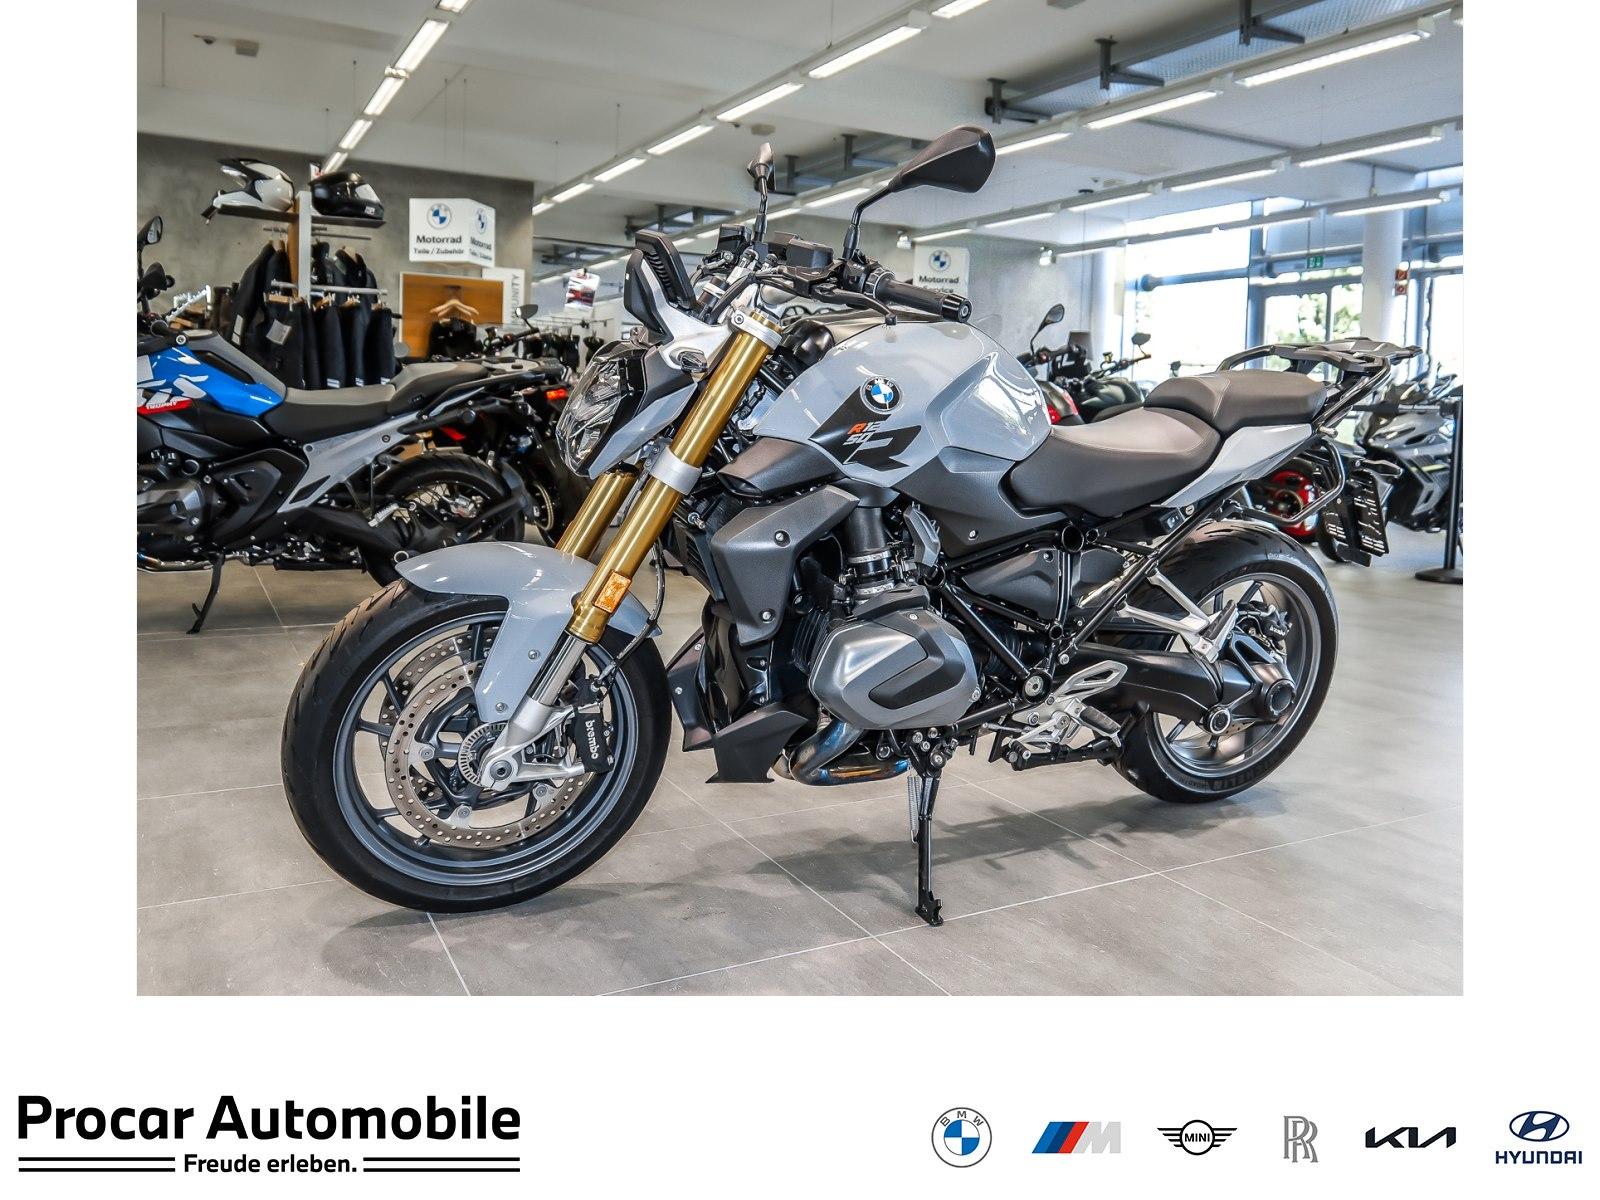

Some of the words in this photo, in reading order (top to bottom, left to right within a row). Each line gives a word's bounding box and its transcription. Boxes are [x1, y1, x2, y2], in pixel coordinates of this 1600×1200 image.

[416, 235, 462, 244] Motorrad
[919, 275, 960, 284] Motorrad
[585, 719, 600, 760] brembo
